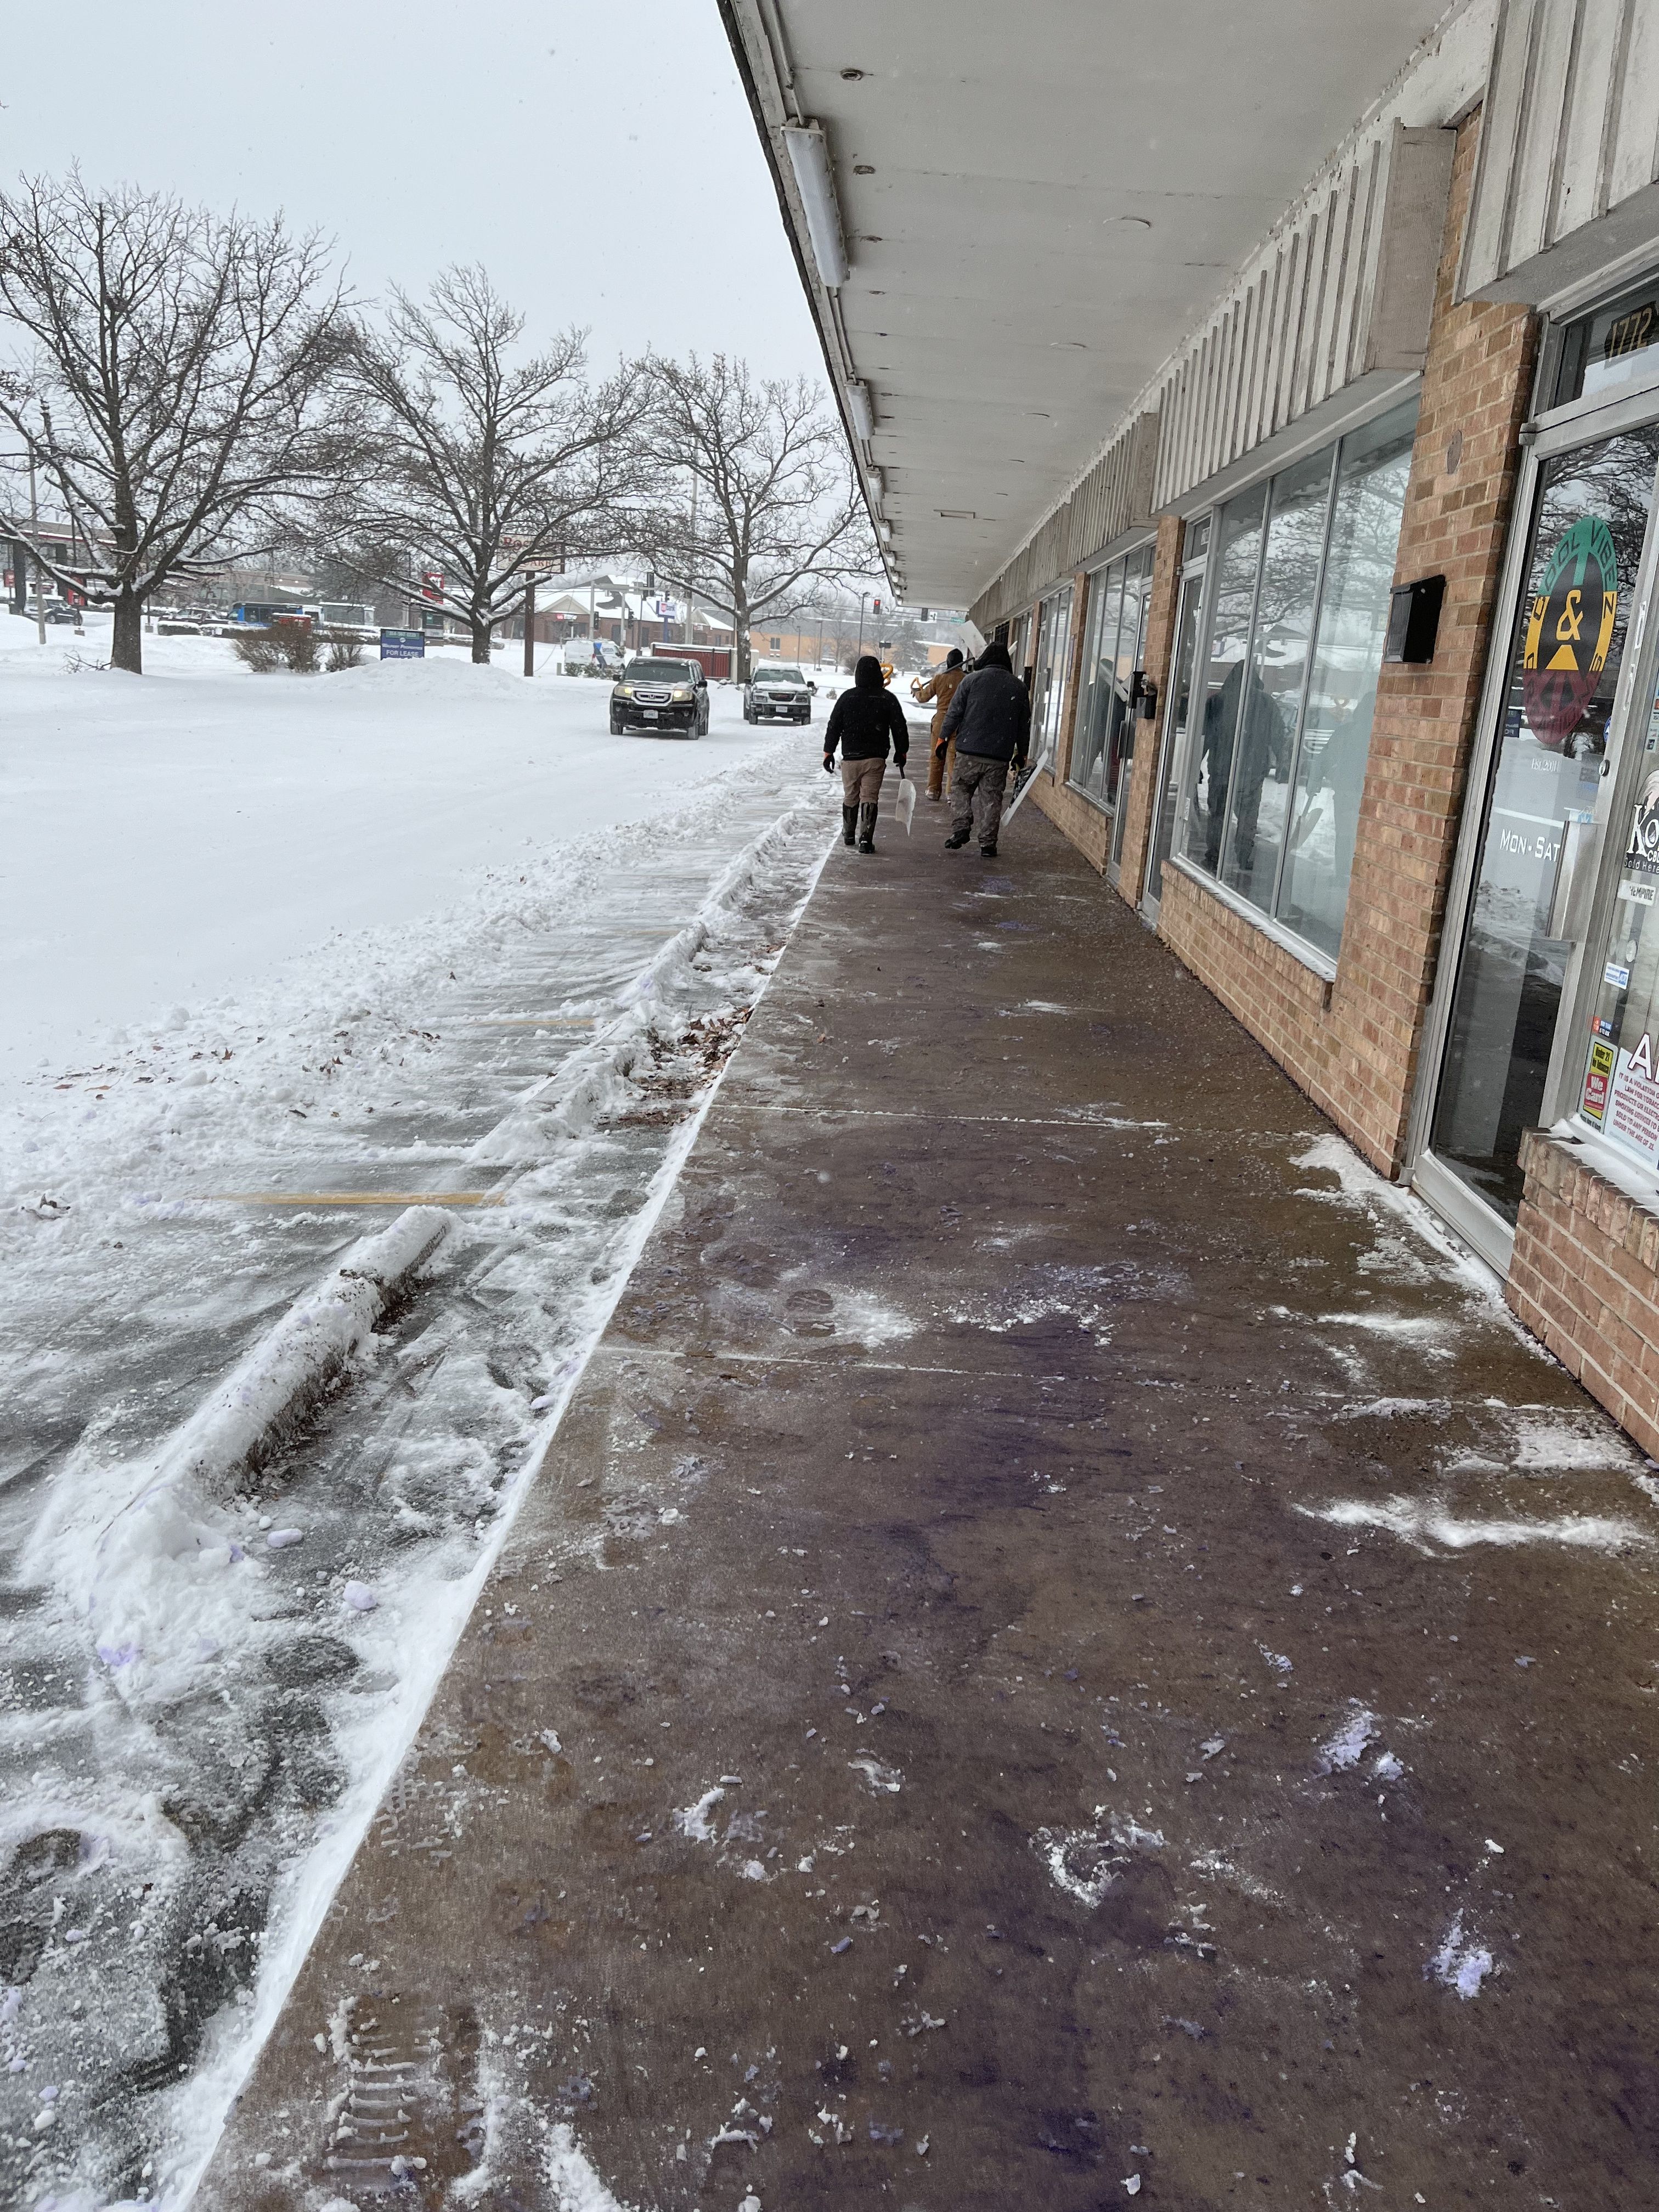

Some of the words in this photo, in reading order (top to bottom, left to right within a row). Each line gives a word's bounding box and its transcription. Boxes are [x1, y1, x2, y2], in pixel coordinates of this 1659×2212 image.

[1610, 307, 1652, 362] 1772
[1533, 532, 1580, 620] COOL
[1591, 520, 1615, 619] VIBEZ
[1556, 589, 1584, 640] &
[1586, 1087, 1605, 1105] Card
[1590, 1076, 1604, 1092] We
[1616, 1110, 1627, 1121] SOLD
